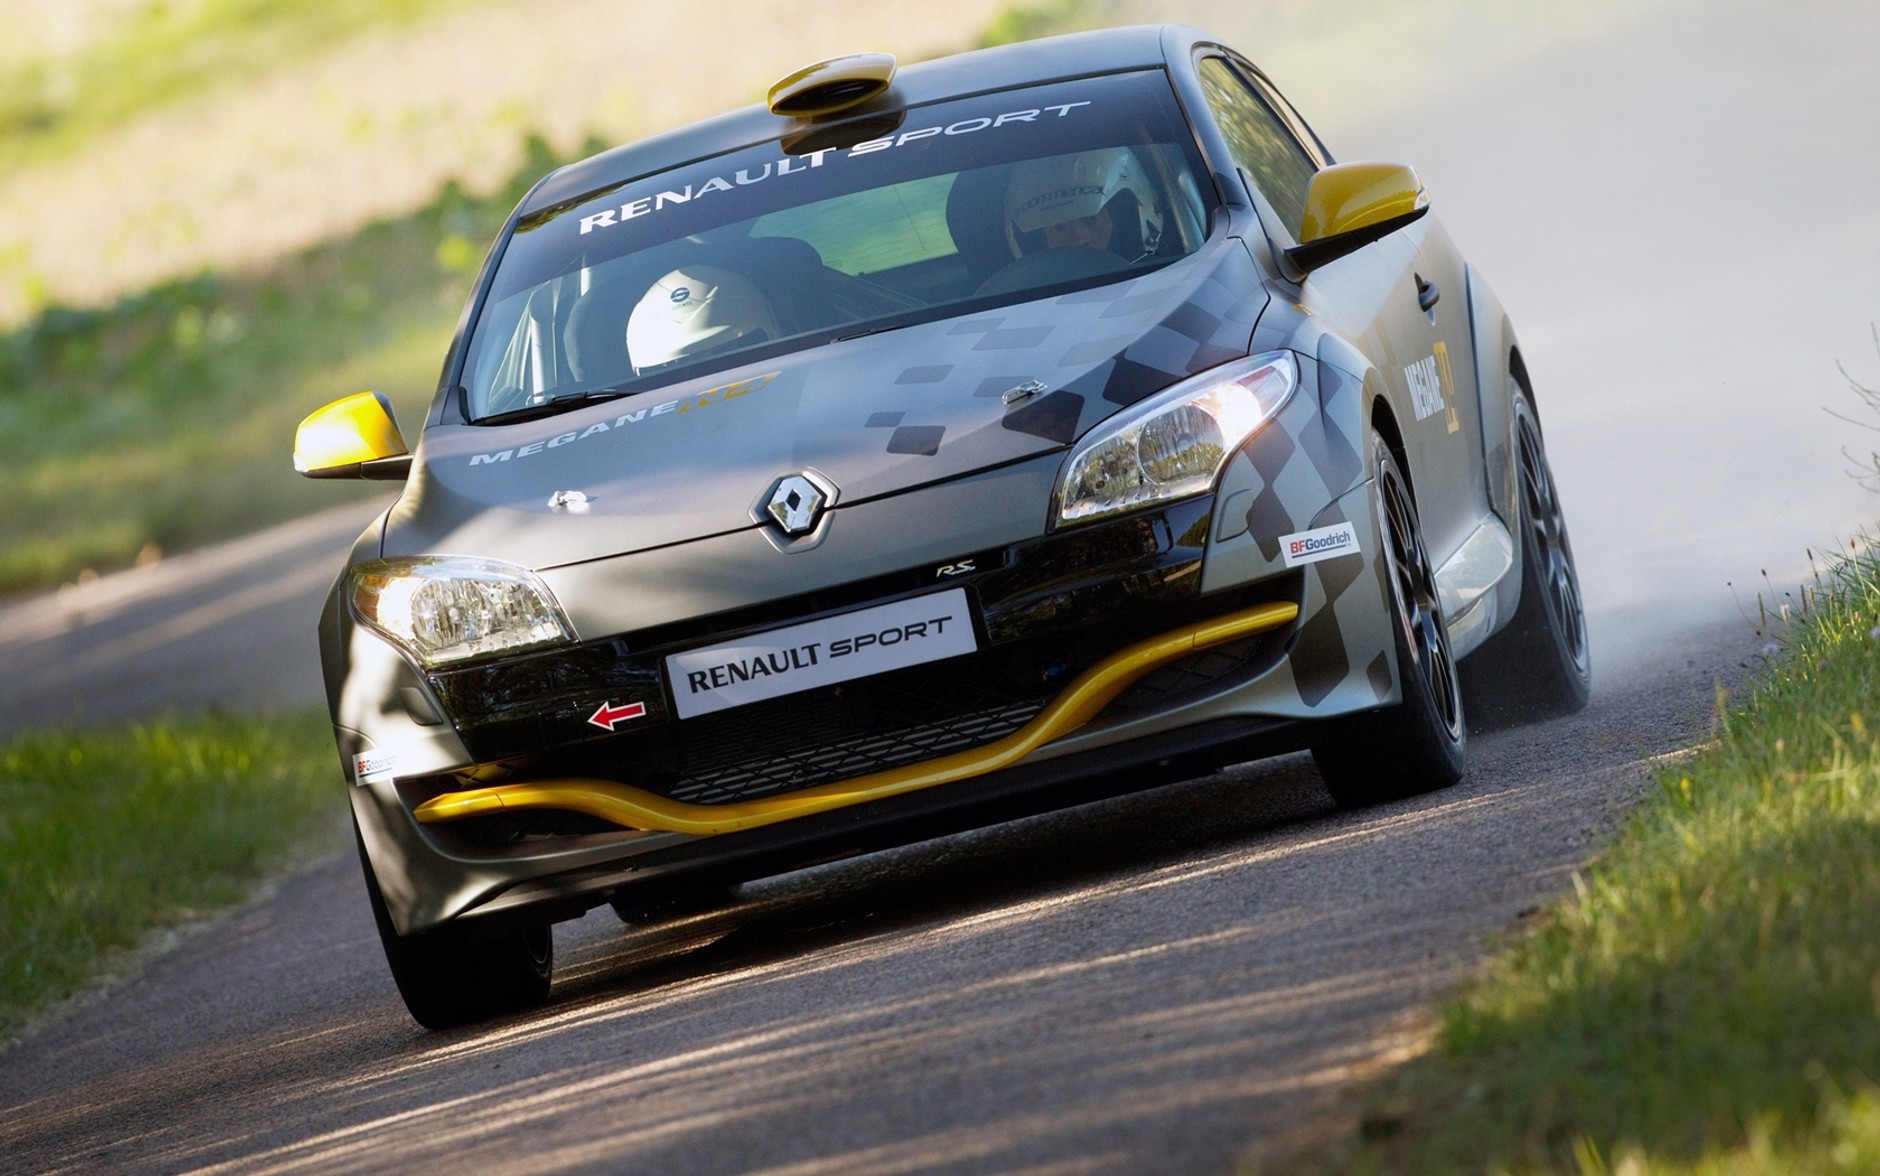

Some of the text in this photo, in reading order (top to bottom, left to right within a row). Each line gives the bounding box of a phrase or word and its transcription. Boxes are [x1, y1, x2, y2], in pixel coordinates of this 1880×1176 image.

[579, 101, 1092, 235] RENAULT SPORT
[469, 400, 679, 466] MEGANE
[1290, 531, 1351, 554] BFGoodrich
[687, 616, 952, 693] RENAULT SPORT
